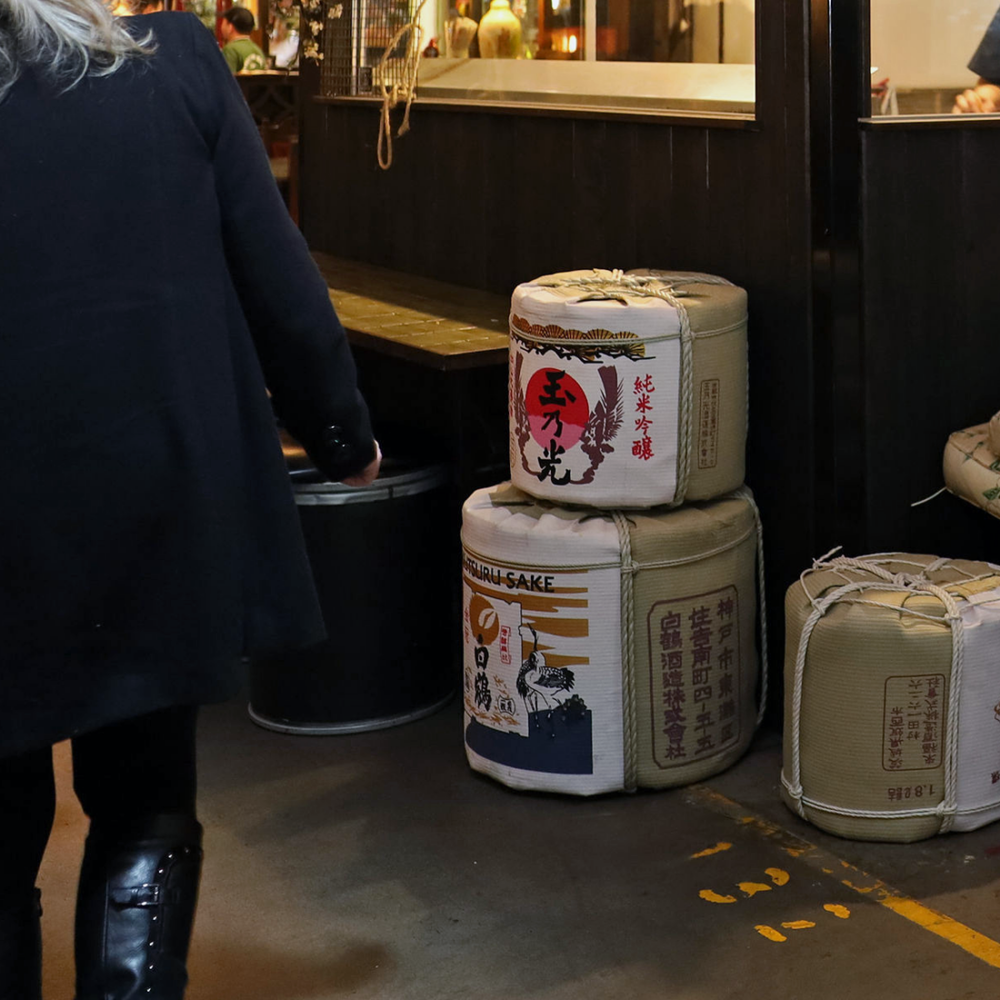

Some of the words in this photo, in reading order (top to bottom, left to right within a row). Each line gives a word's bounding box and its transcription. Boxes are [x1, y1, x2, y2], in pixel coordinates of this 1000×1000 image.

[537, 369, 577, 486] 玉乃光
[505, 571, 555, 593] SAKE
